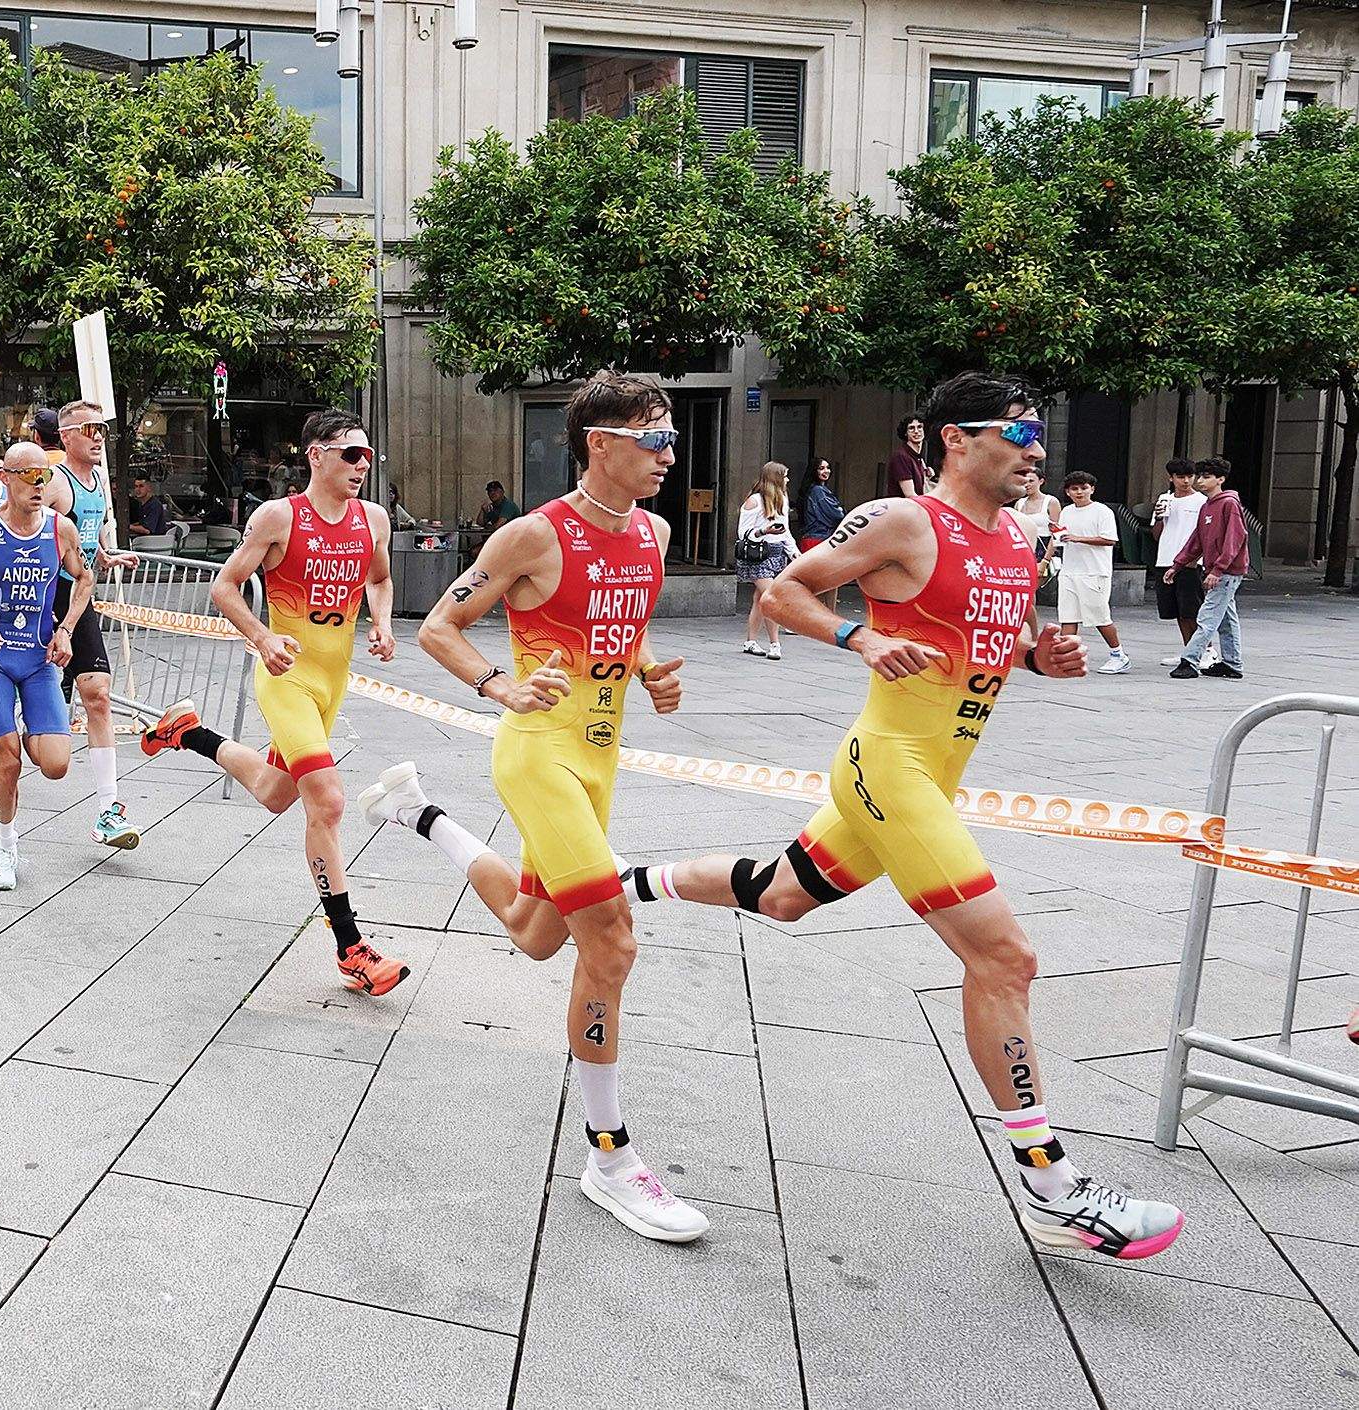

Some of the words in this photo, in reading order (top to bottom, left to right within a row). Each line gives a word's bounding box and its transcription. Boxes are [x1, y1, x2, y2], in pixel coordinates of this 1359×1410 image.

[79, 532, 98, 543] BEL
[2, 567, 49, 583] ANDRE
[304, 558, 361, 582] POUSADA
[604, 567, 616, 577] LA
[983, 566, 995, 576] LA
[10, 585, 37, 601] FRA
[310, 584, 349, 607] ESP
[451, 586, 474, 604] 4
[586, 588, 649, 619] MARTIN
[965, 588, 1029, 628] SERRAT
[590, 624, 636, 656] ESP
[971, 629, 1014, 667] ESP
[849, 737, 885, 822] orca
[584, 1022, 605, 1046] 4
